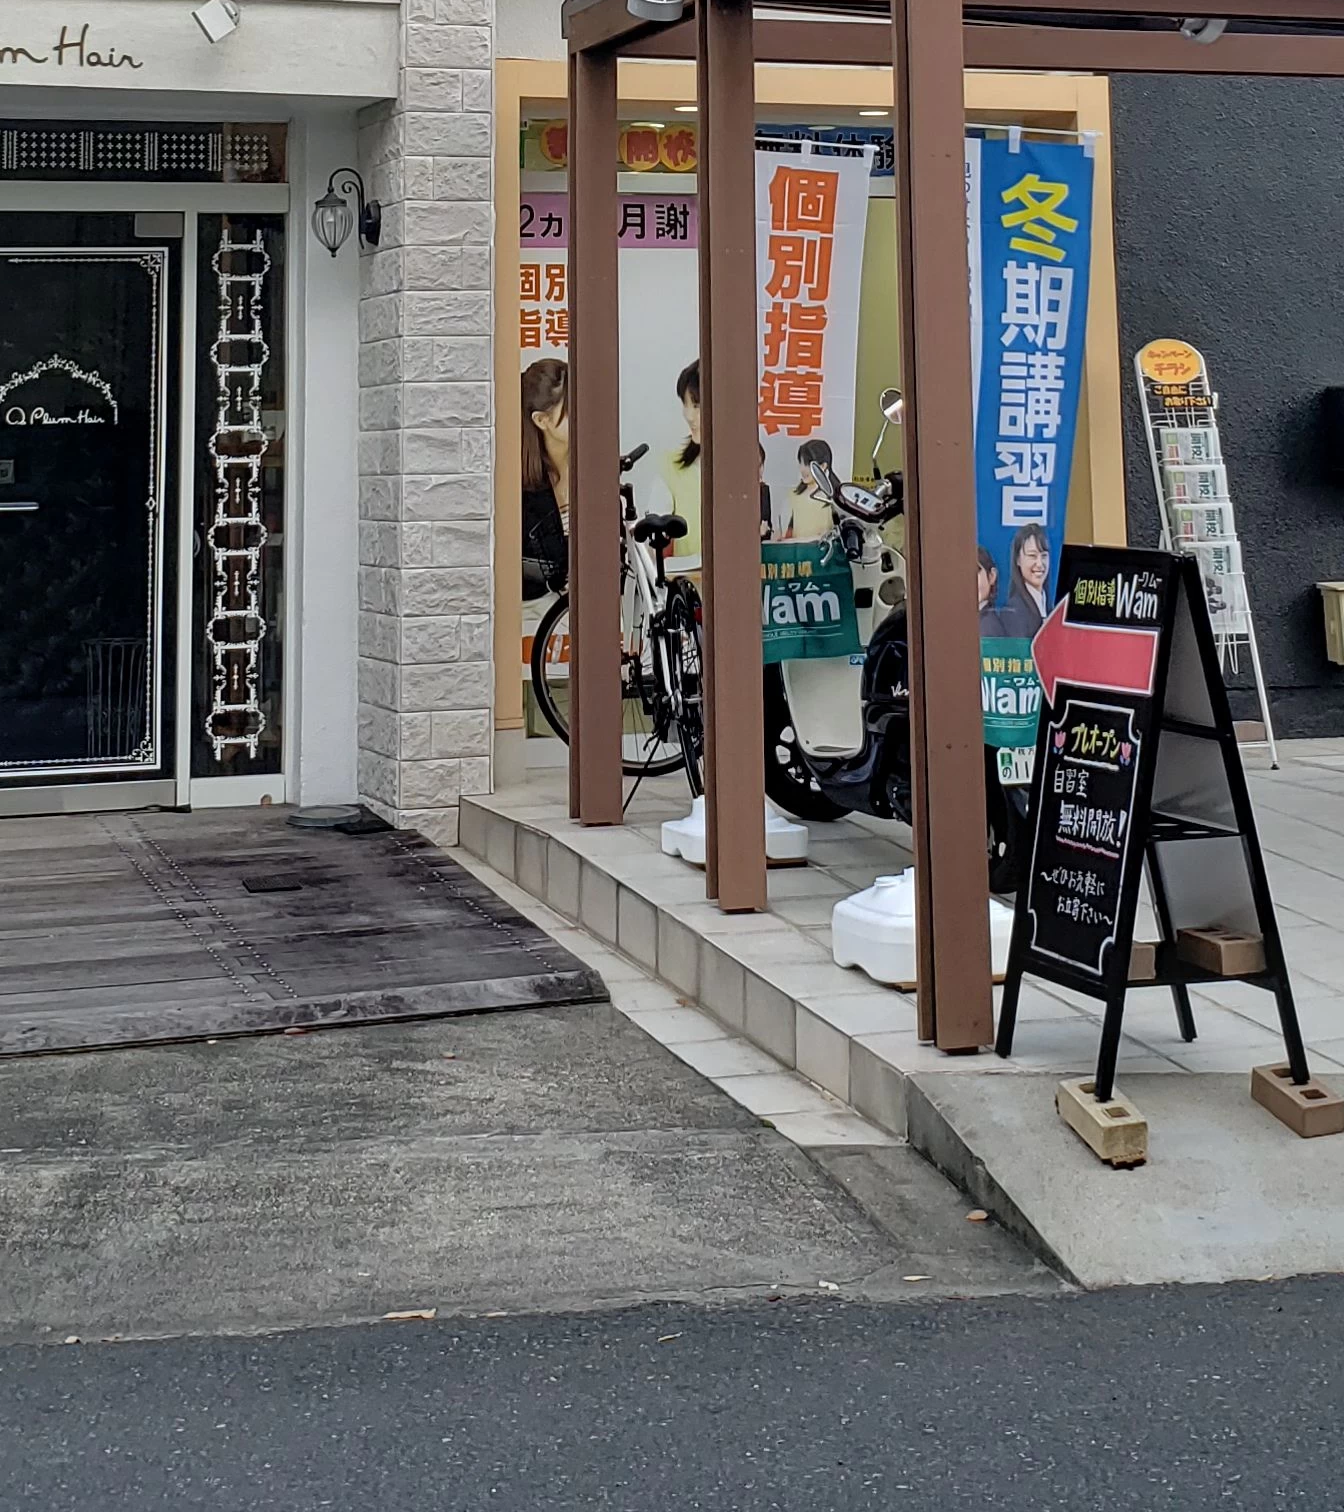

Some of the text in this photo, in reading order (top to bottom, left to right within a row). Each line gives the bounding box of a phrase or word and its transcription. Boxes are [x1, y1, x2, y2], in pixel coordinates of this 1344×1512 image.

[53, 23, 143, 68] Hair
[757, 165, 840, 437] 個別指導
[994, 172, 1079, 527] 冬期講習
[1154, 362, 1191, 376] チラシ
[77, 408, 105, 424] Hair
[1074, 577, 1116, 607] 個別指導
[1116, 573, 1158, 619] Wam
[1071, 723, 1121, 758] プレオープン
[1054, 763, 1090, 798] 自習室
